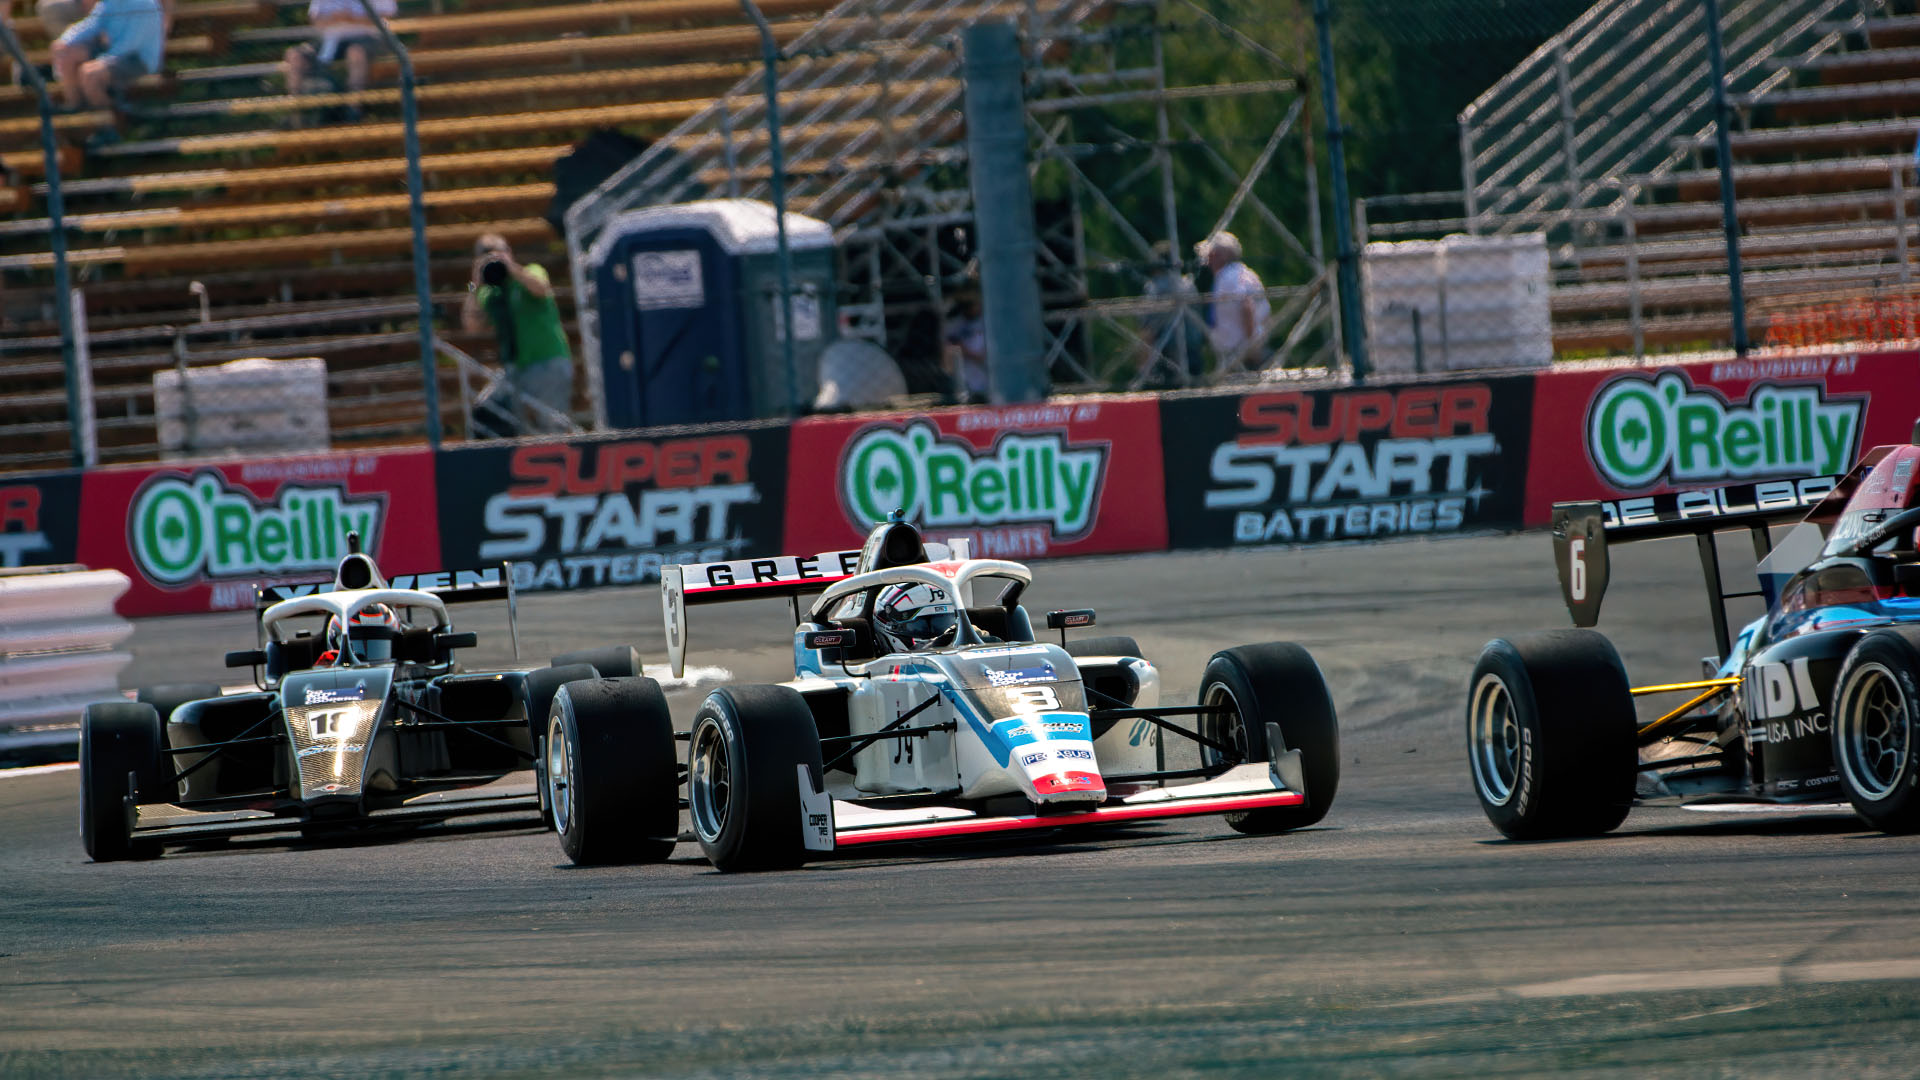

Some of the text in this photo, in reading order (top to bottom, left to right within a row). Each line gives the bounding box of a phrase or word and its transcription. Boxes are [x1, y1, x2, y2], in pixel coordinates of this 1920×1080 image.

[1711, 356, 1860, 382] EXCLUSIVELY AT
[1236, 383, 1492, 448] SUPER
[1600, 383, 1851, 476] O'Reilly
[508, 435, 751, 499] SUPER
[854, 434, 1092, 524] O'Reilly
[1205, 432, 1499, 507] START
[143, 484, 371, 572] O'Reilly
[479, 483, 759, 559] START
[982, 527, 1048, 556] PARTS
[1234, 498, 1467, 542] BATTERIES
[514, 548, 727, 591] BATTERIES
[706, 551, 862, 587] GREE
[1570, 536, 1587, 603] 6
[668, 588, 680, 648] 3
[705, 699, 735, 742] COOPER
[1767, 713, 1828, 743] USA INC
[1025, 750, 1090, 766] PEASUS
[1516, 728, 1532, 816] COOPER
[808, 814, 828, 826] COOPER
